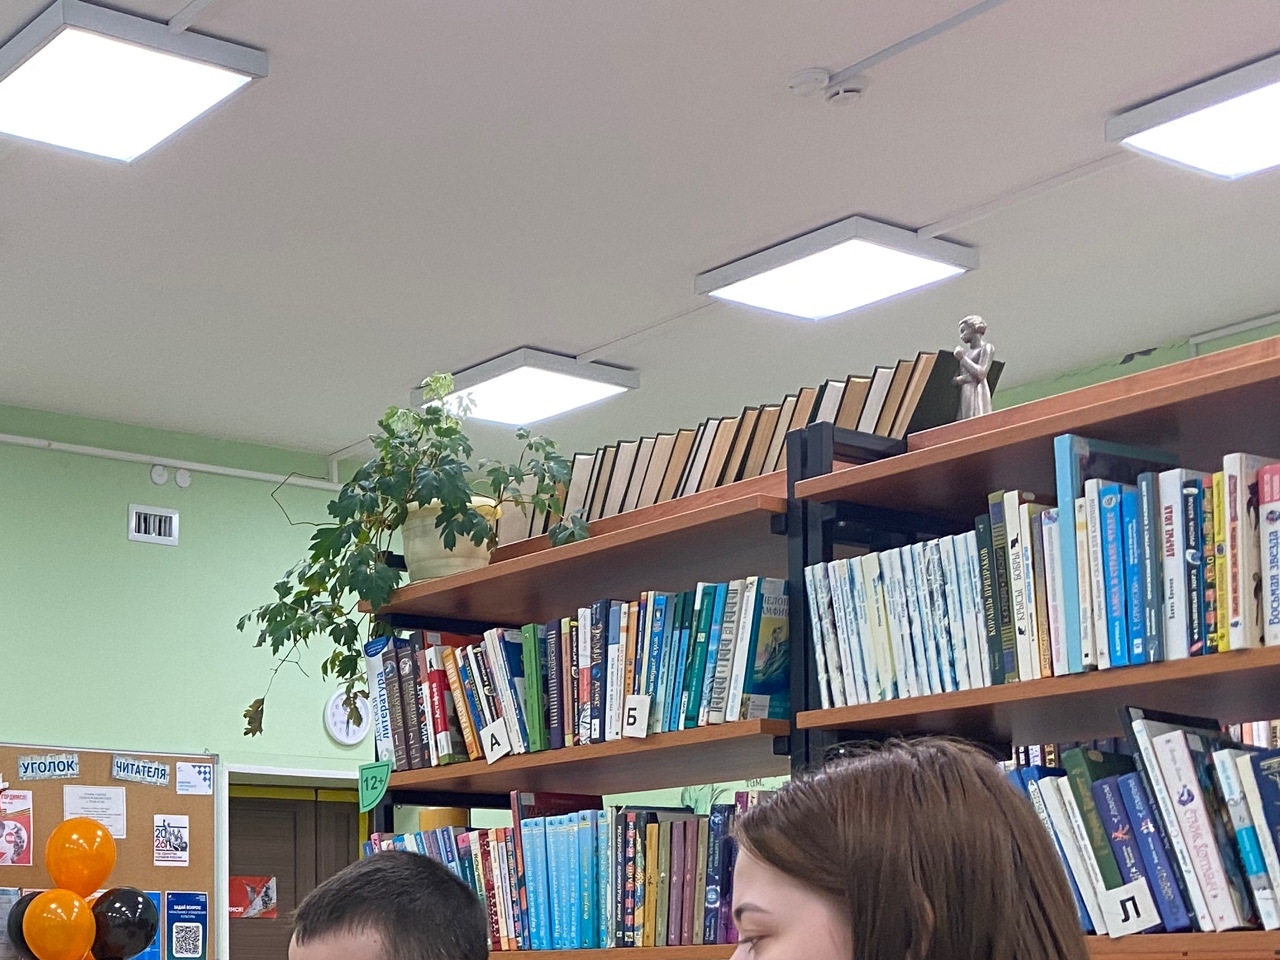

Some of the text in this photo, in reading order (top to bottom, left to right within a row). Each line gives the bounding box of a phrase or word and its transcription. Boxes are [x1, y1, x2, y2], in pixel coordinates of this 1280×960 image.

[980, 548, 996, 636] КОРАБЛЬ ПРИЗРАКОВ
[1012, 552, 1025, 621] КРЫСЫ БОБРЫ
[1268, 531, 1280, 625] Восьмая звезда
[377, 671, 390, 739] литература
[393, 682, 403, 727] ЛИТЕРАТУРЫ
[408, 680, 417, 725] ЛИТЕРАТУРЫ
[431, 682, 441, 718] Астафьев
[372, 697, 382, 742] Детская
[626, 707, 637, 726] Б
[394, 735, 399, 745] 1
[409, 732, 414, 744] 2
[490, 732, 502, 752] А
[21, 759, 167, 781] УГОЛОК ЧИТАТЕЛЯ
[363, 775, 385, 792] 12+
[155, 828, 166, 838] 20
[155, 838, 166, 848] 26
[1119, 895, 1141, 923] Л
